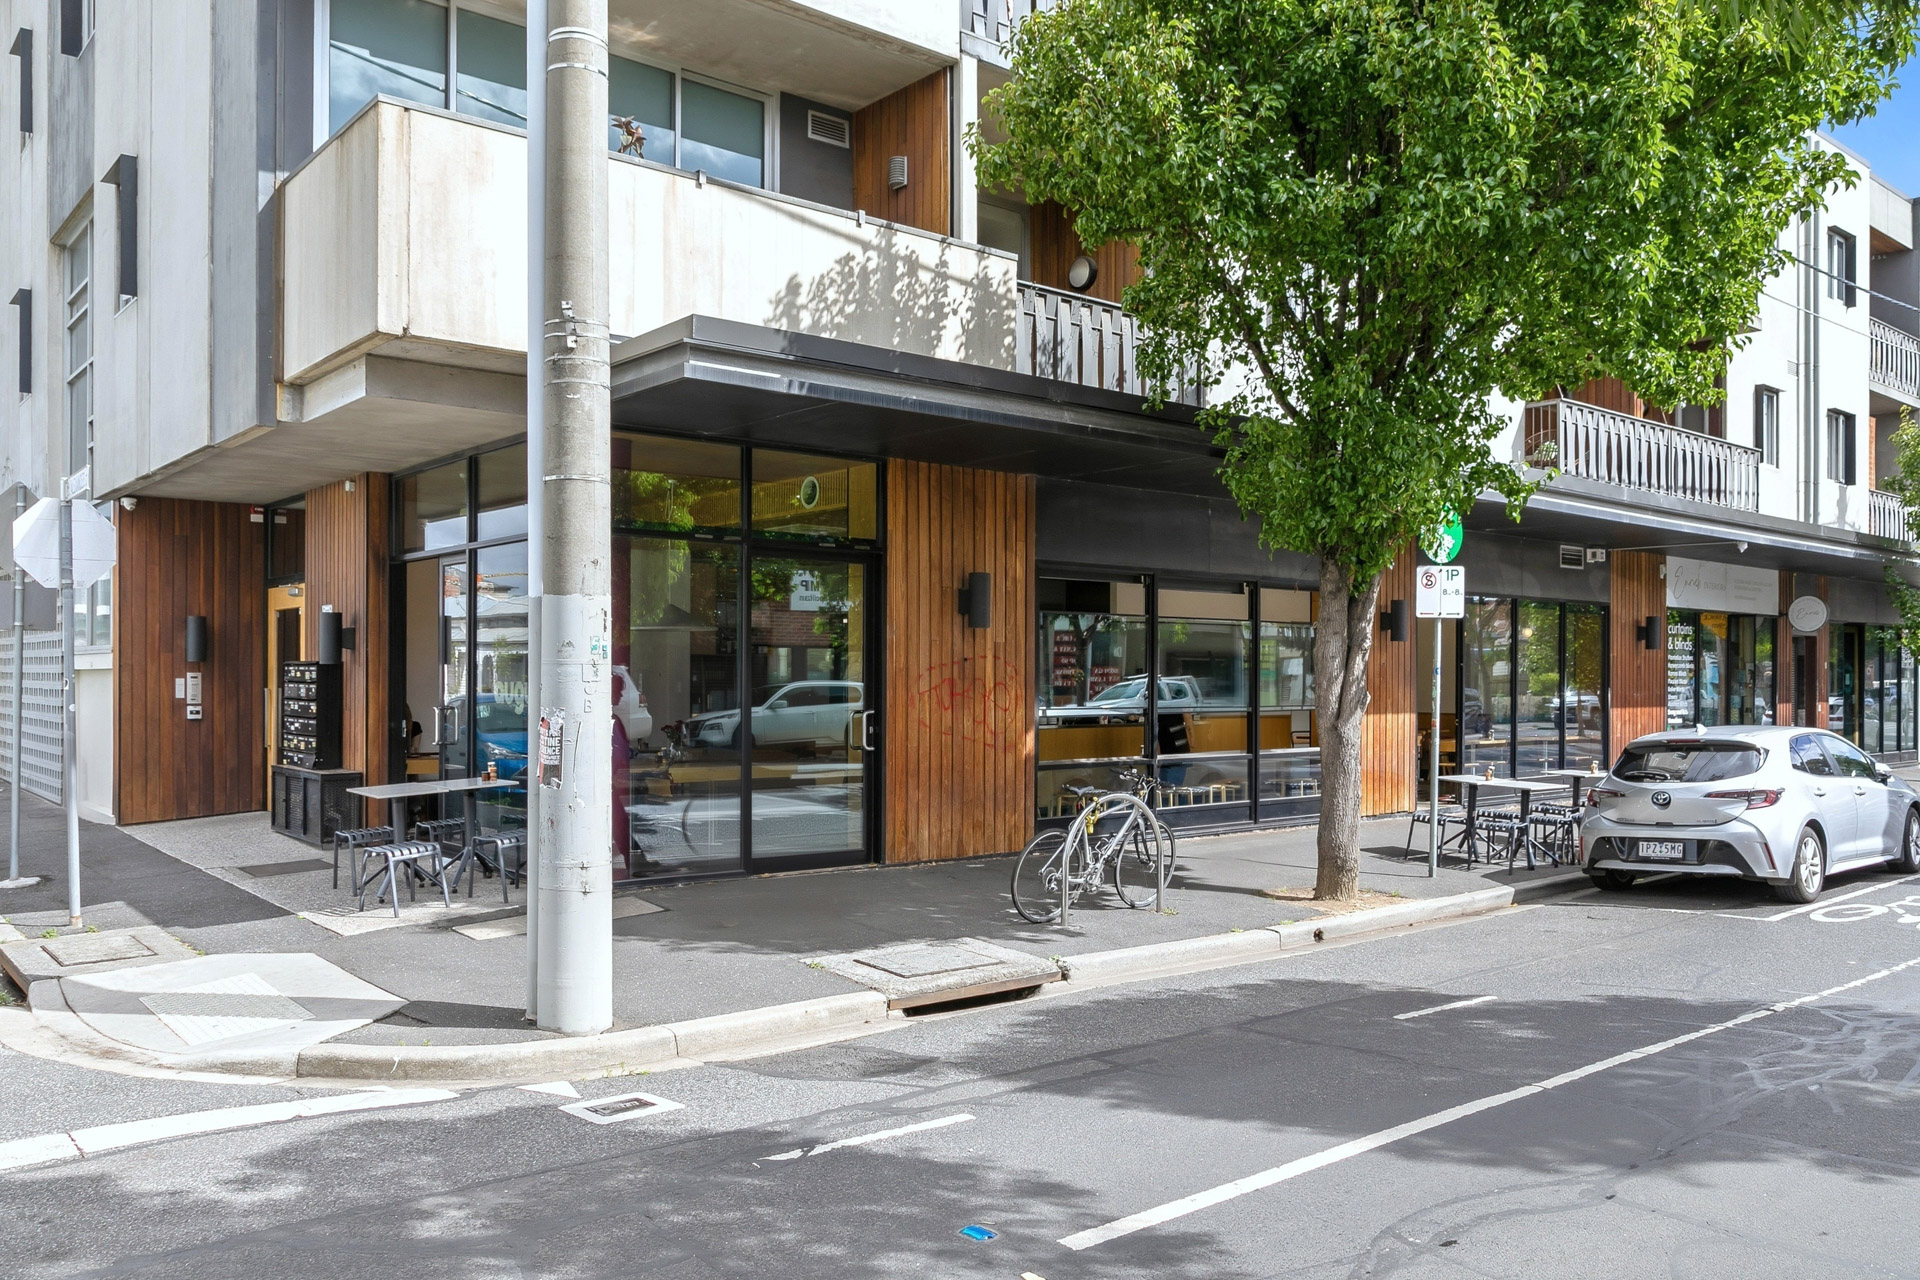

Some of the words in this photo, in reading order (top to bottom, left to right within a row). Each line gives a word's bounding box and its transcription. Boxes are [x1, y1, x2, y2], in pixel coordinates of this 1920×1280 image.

[1445, 569, 1460, 581] 1P
[1667, 622, 1693, 635] curtains
[1667, 637, 1674, 650] &
[1674, 637, 1693, 651] blinds
